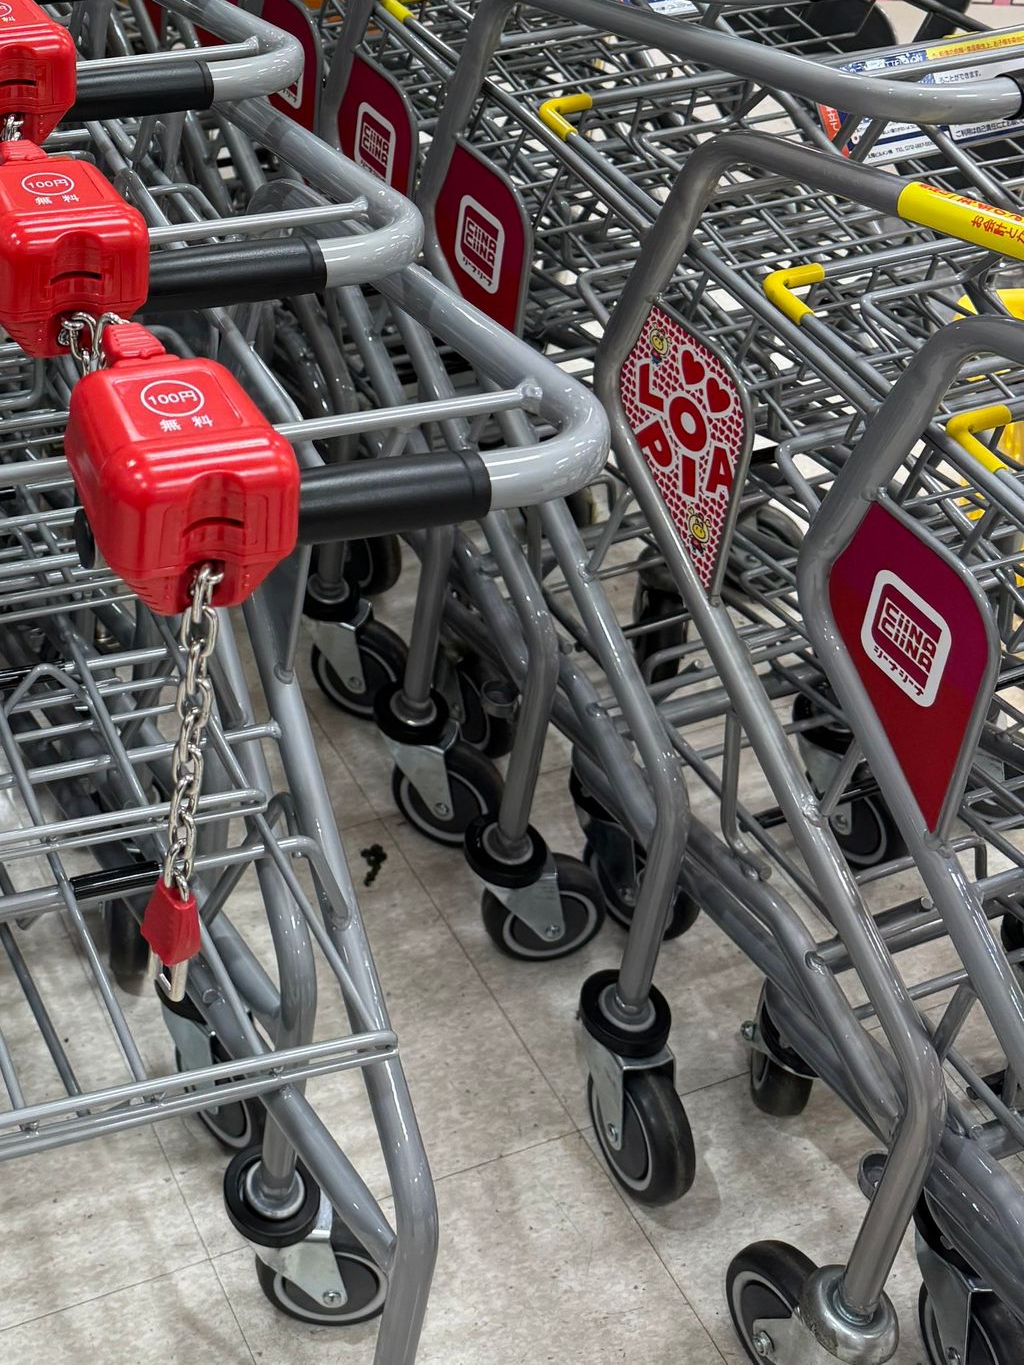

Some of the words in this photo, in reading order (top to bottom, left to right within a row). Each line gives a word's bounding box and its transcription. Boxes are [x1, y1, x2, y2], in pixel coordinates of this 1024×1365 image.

[26, 177, 70, 190] 100円
[147, 387, 198, 407] 100円
[159, 414, 213, 432] 無料
[873, 643, 925, 697] シーナシーナ
